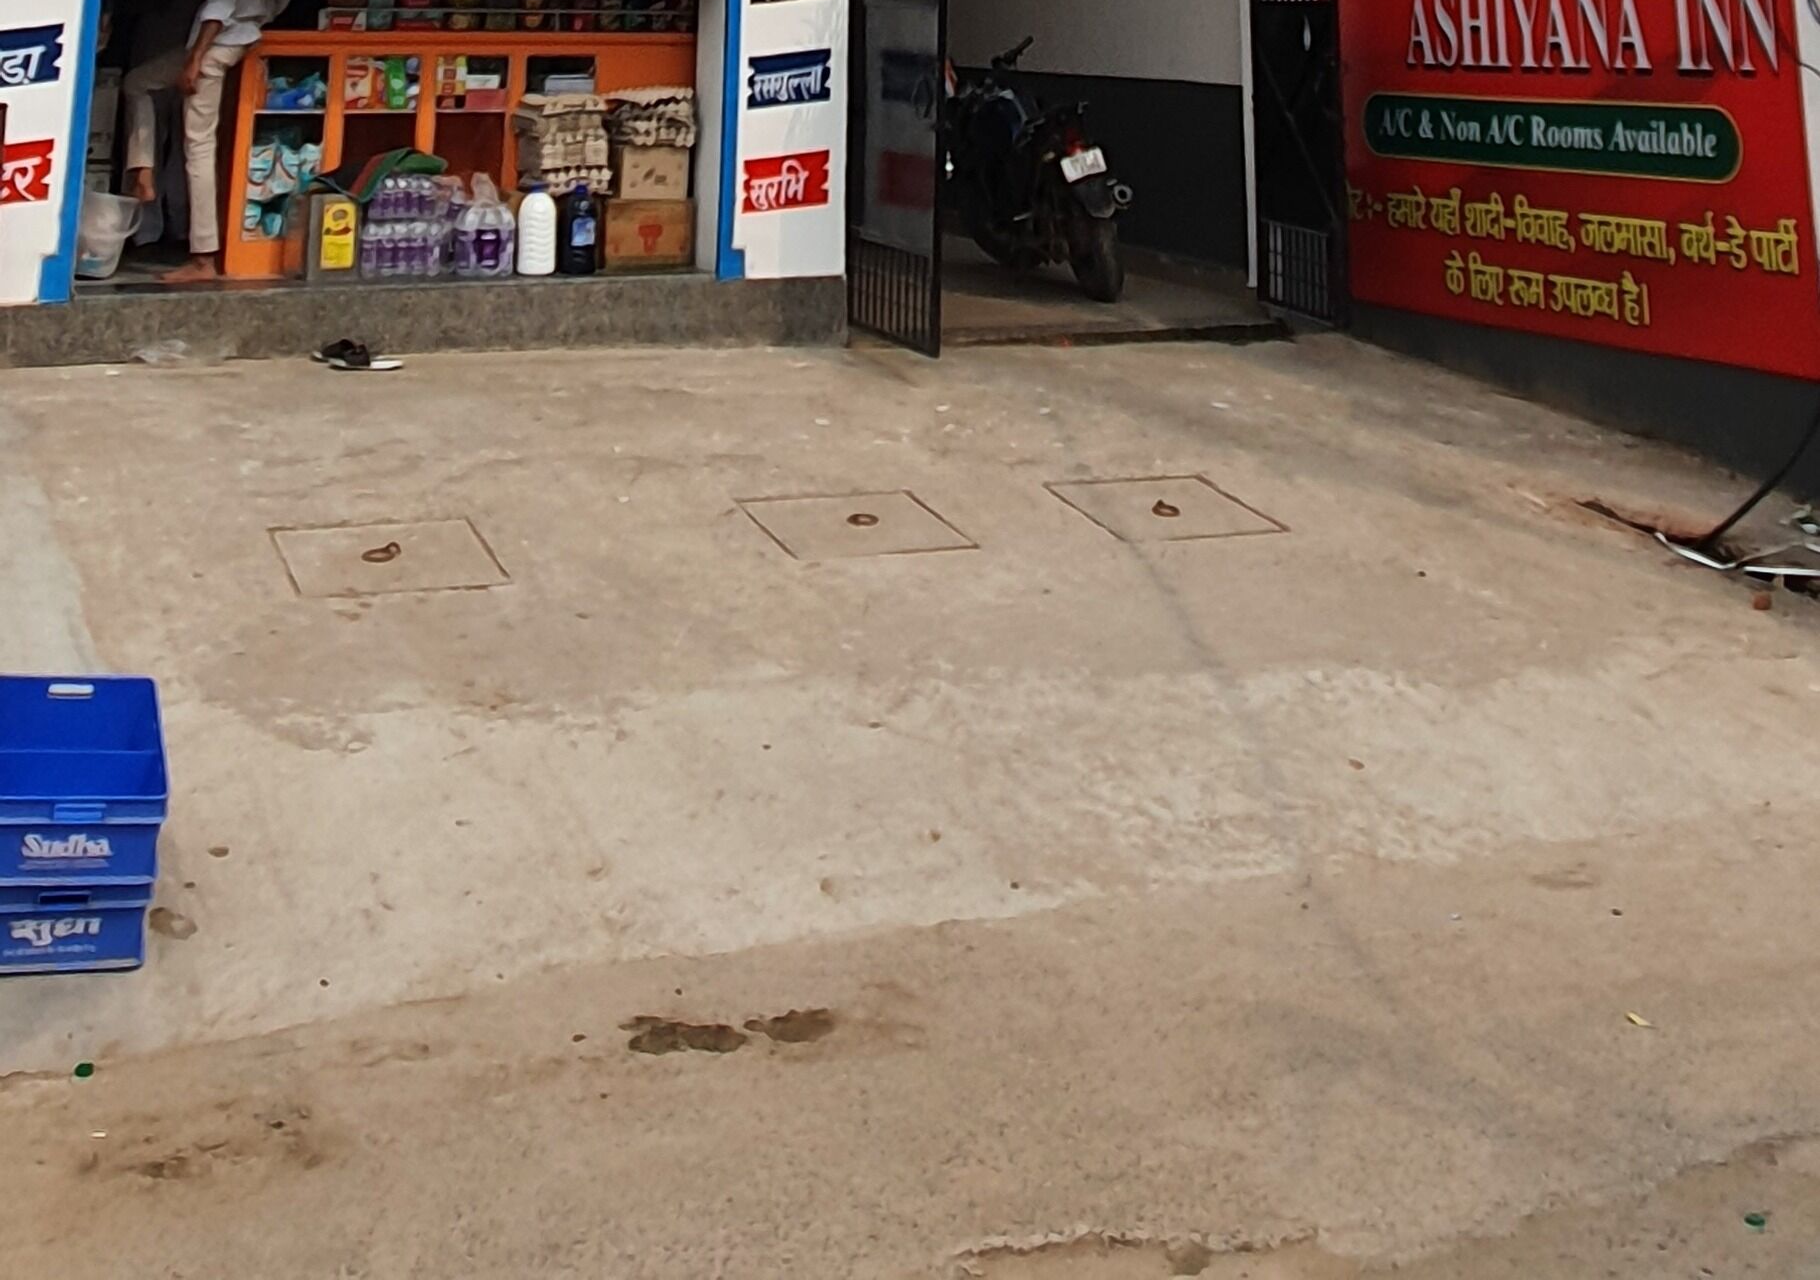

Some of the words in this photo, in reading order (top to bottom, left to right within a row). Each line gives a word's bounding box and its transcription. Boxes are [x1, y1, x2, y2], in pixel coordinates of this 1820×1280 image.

[1417, 111, 1434, 139] &
[1440, 109, 1481, 143] Non
[1484, 114, 1524, 146] A/C
[1530, 114, 1603, 151] Rooms
[1607, 120, 1718, 158] Available
[1444, 250, 1465, 295] के
[1468, 251, 1504, 306] लिए
